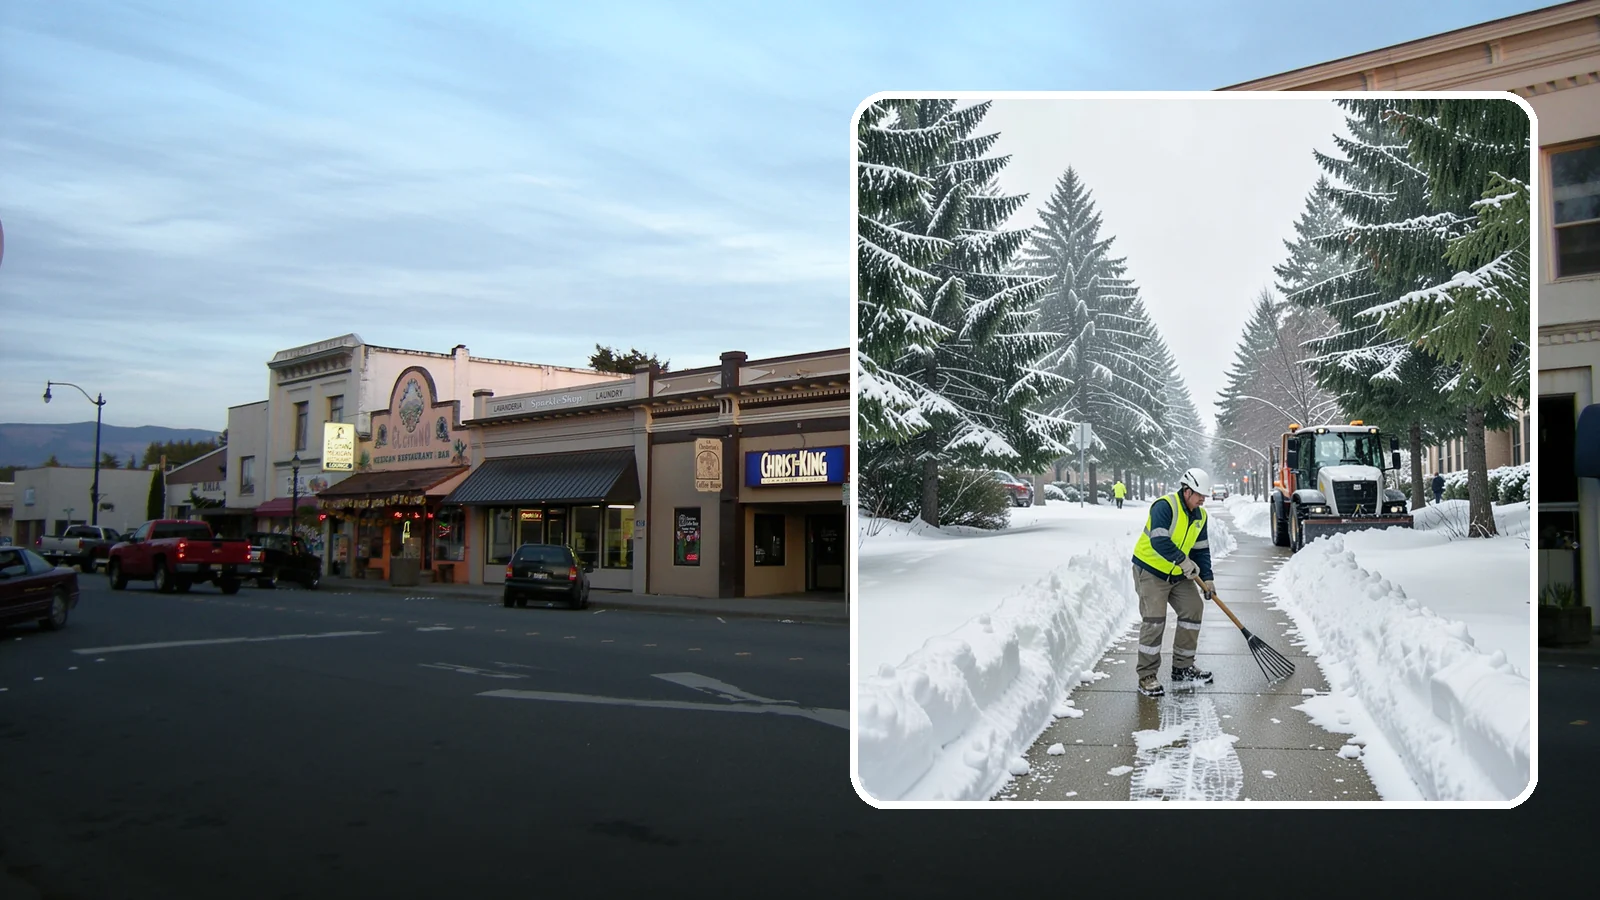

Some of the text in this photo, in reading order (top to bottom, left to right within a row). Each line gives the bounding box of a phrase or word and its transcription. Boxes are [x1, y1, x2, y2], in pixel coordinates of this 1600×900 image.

[531, 394, 583, 409] Sparkle Shop
[595, 389, 624, 400] LAUNDRY
[493, 402, 523, 413] LAVANDERIA
[373, 454, 396, 464] MEXICAN
[397, 451, 433, 462] RESTAURANT
[438, 450, 450, 459] BAR
[761, 450, 828, 478] CHRIST KING
